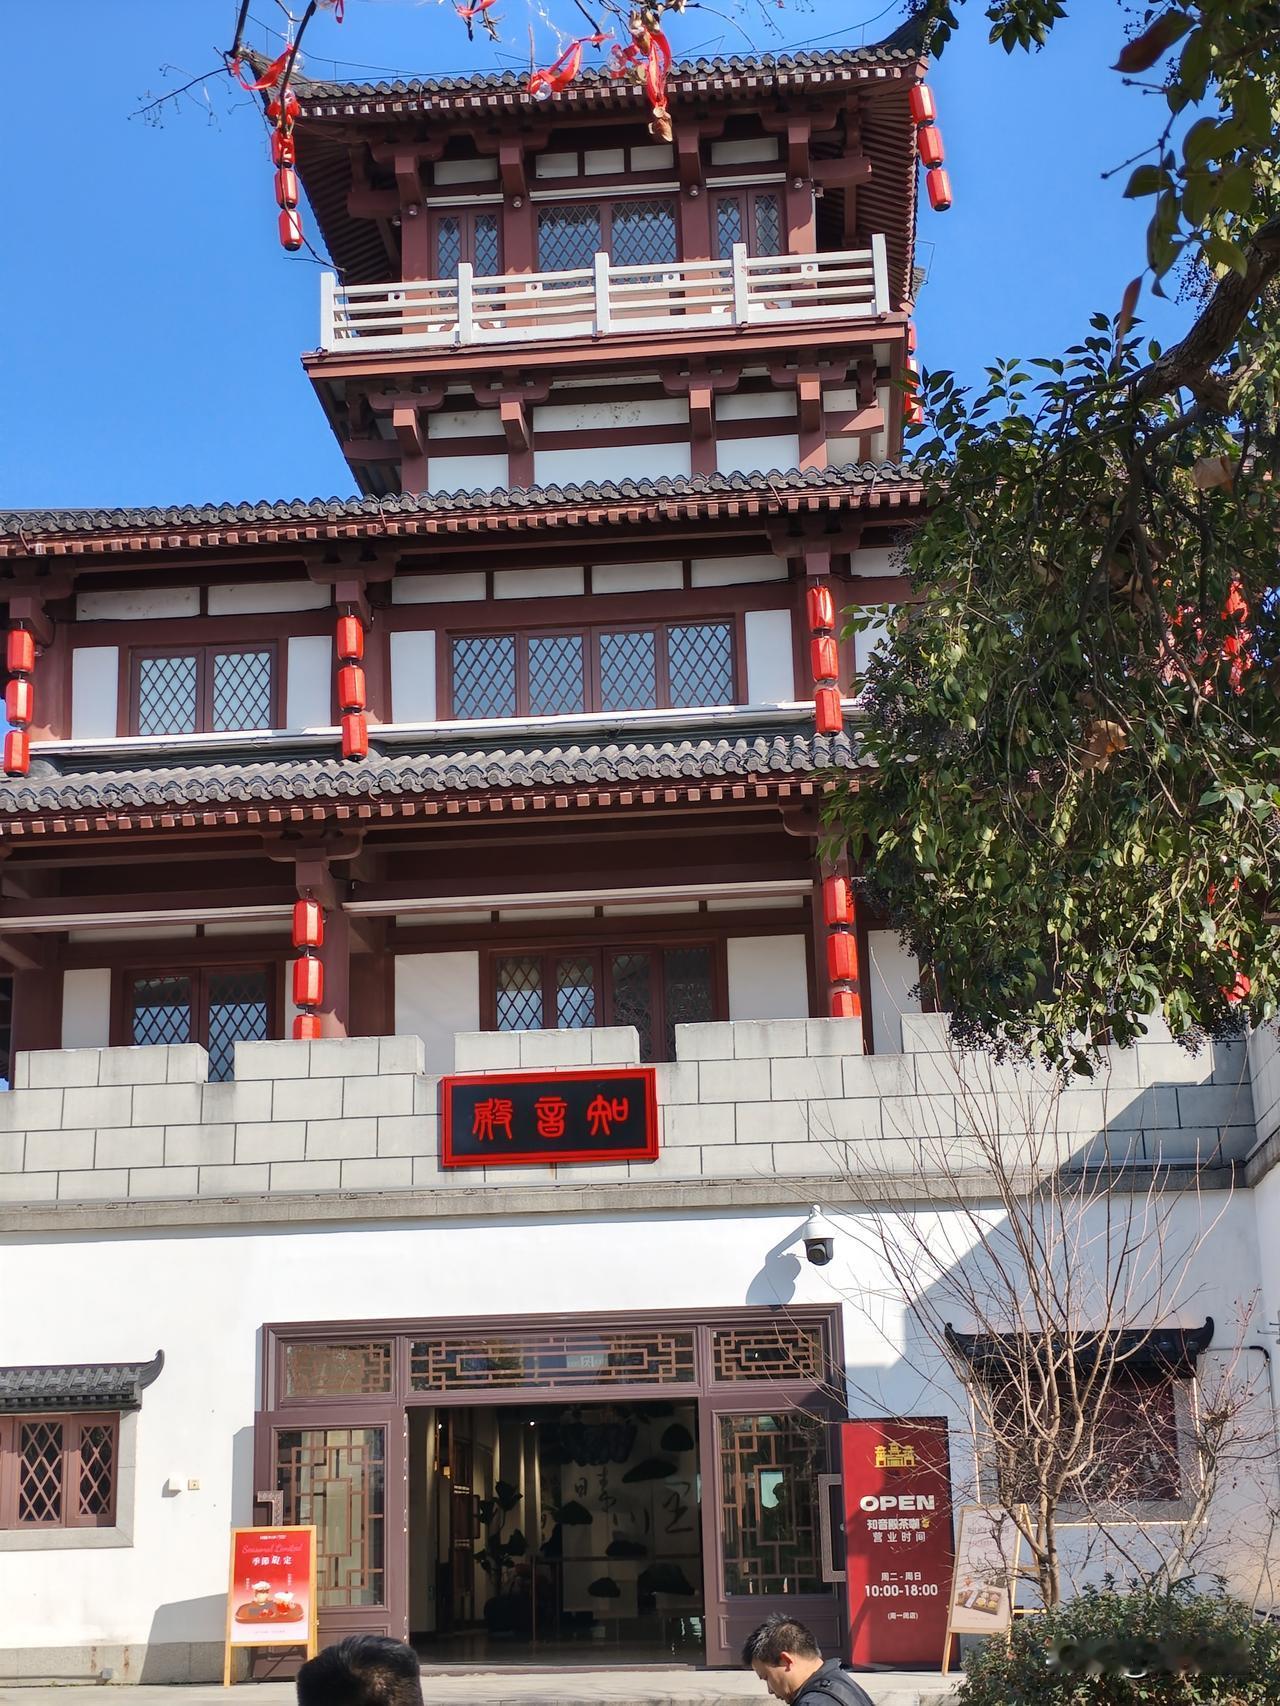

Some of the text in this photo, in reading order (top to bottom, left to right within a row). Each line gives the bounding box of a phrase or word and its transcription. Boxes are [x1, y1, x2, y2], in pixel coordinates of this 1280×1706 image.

[860, 1495, 935, 1511] OPEN
[872, 1531, 926, 1543] 营业时间
[865, 1584, 938, 1597] 10:00-18:00
